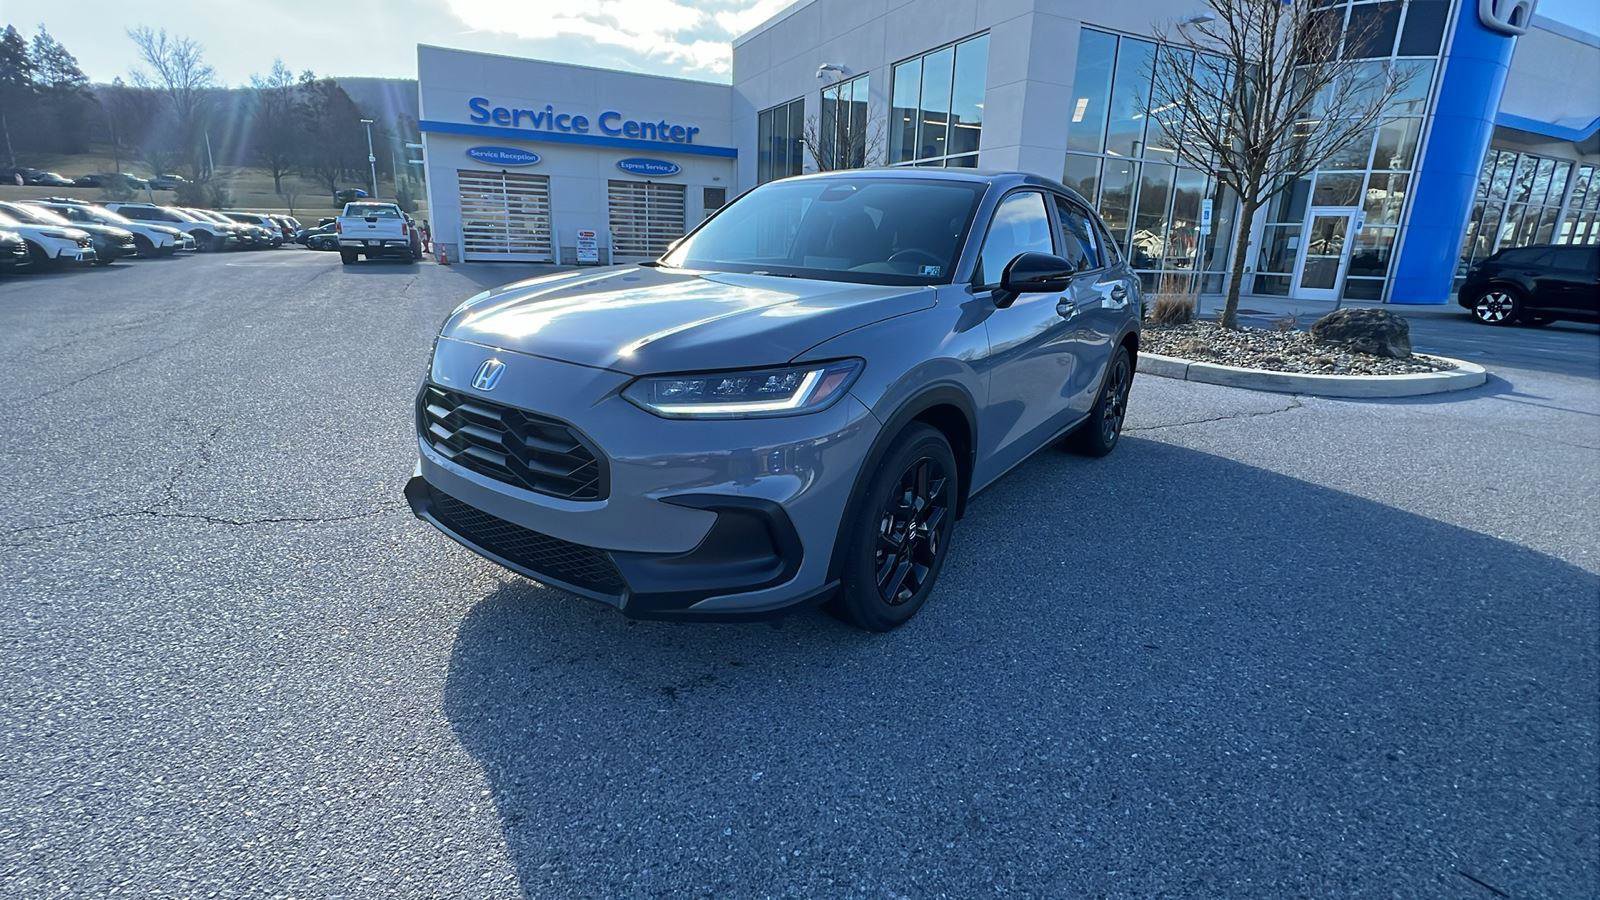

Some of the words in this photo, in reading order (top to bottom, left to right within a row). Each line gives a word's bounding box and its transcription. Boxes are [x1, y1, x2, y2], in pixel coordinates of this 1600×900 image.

[469, 97, 589, 133] Service
[598, 111, 699, 143] Center
[471, 149, 498, 158] Service
[500, 152, 536, 161] Reception
[621, 161, 645, 169] Express
[645, 163, 668, 171] Service
